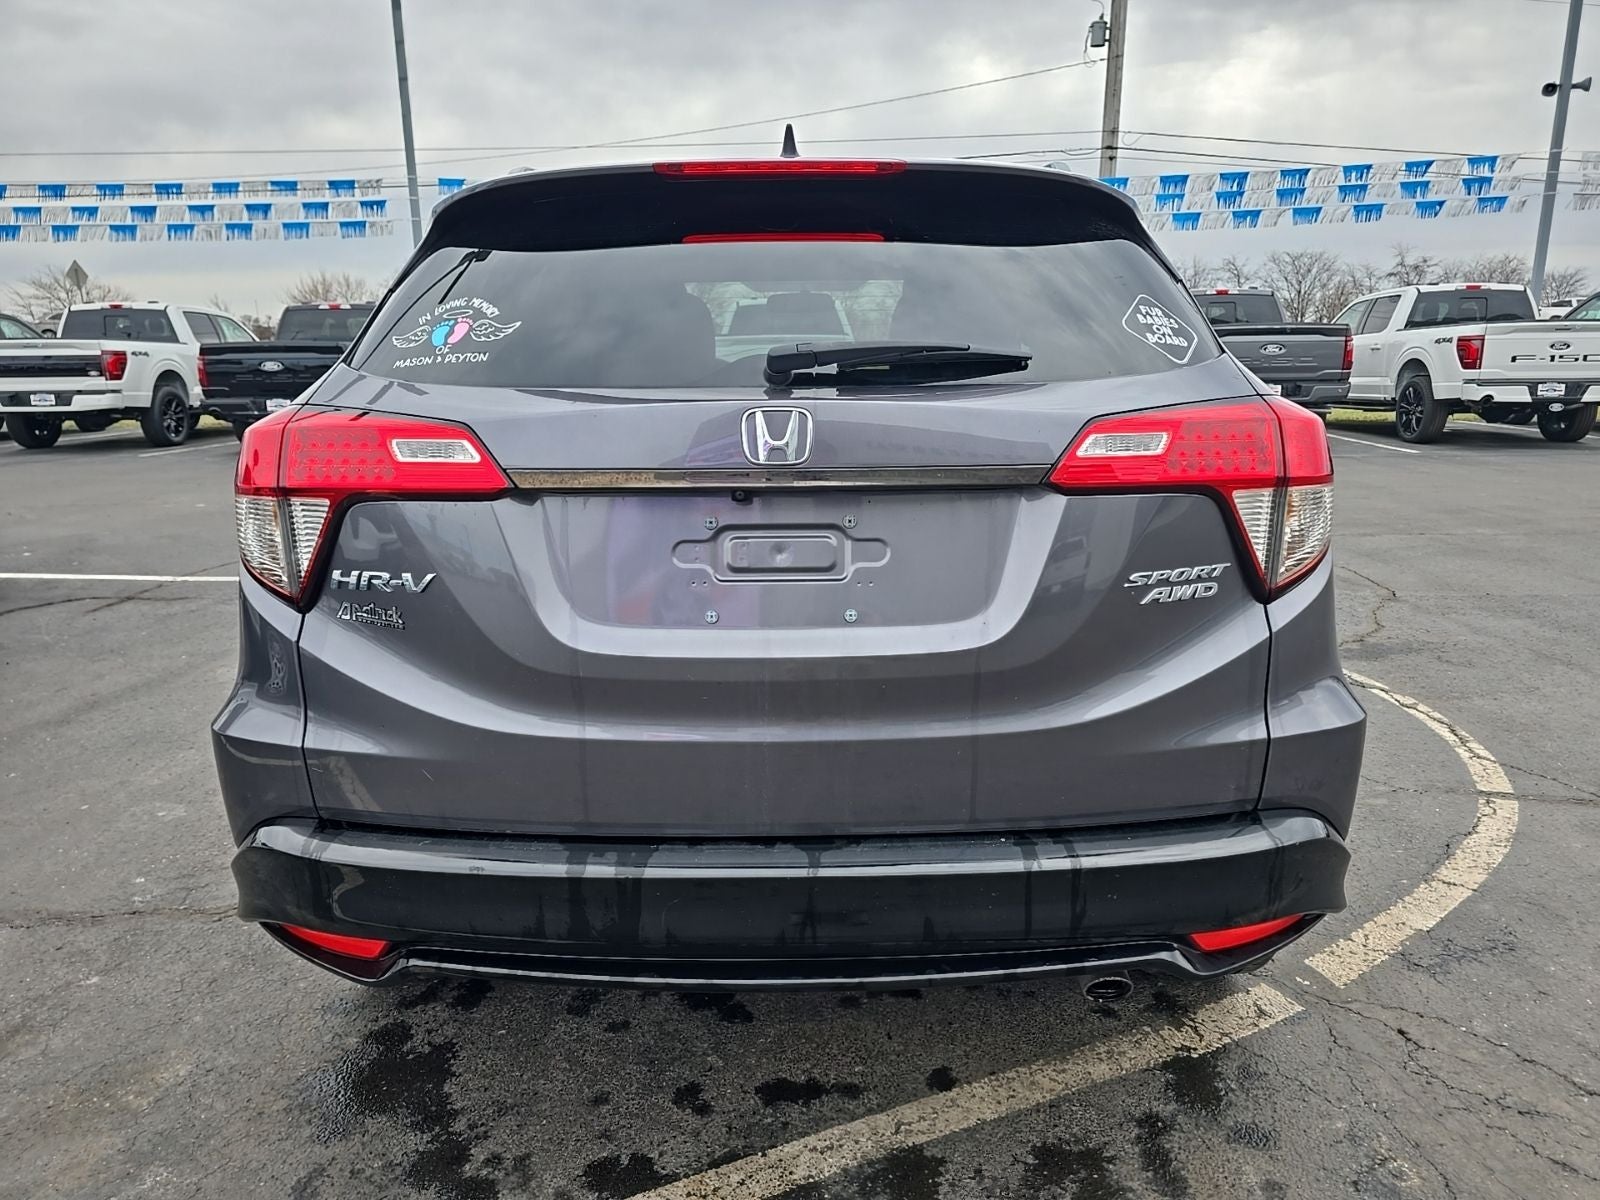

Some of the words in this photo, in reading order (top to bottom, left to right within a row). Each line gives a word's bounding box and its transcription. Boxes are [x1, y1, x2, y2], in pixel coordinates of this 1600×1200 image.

[418, 312, 431, 325] IN
[434, 297, 468, 316] LOVING
[469, 297, 500, 318] MEMORY
[1138, 305, 1165, 319] FUR
[1136, 313, 1179, 329] BABIES
[1152, 324, 1173, 335] ON
[1145, 333, 1188, 347] BOARD
[435, 344, 452, 355] OF
[393, 355, 434, 369] MASON
[444, 352, 489, 364] PEYTON
[330, 569, 437, 593] HR-V
[1123, 562, 1232, 588] SPORT
[1139, 582, 1219, 605] AWD
